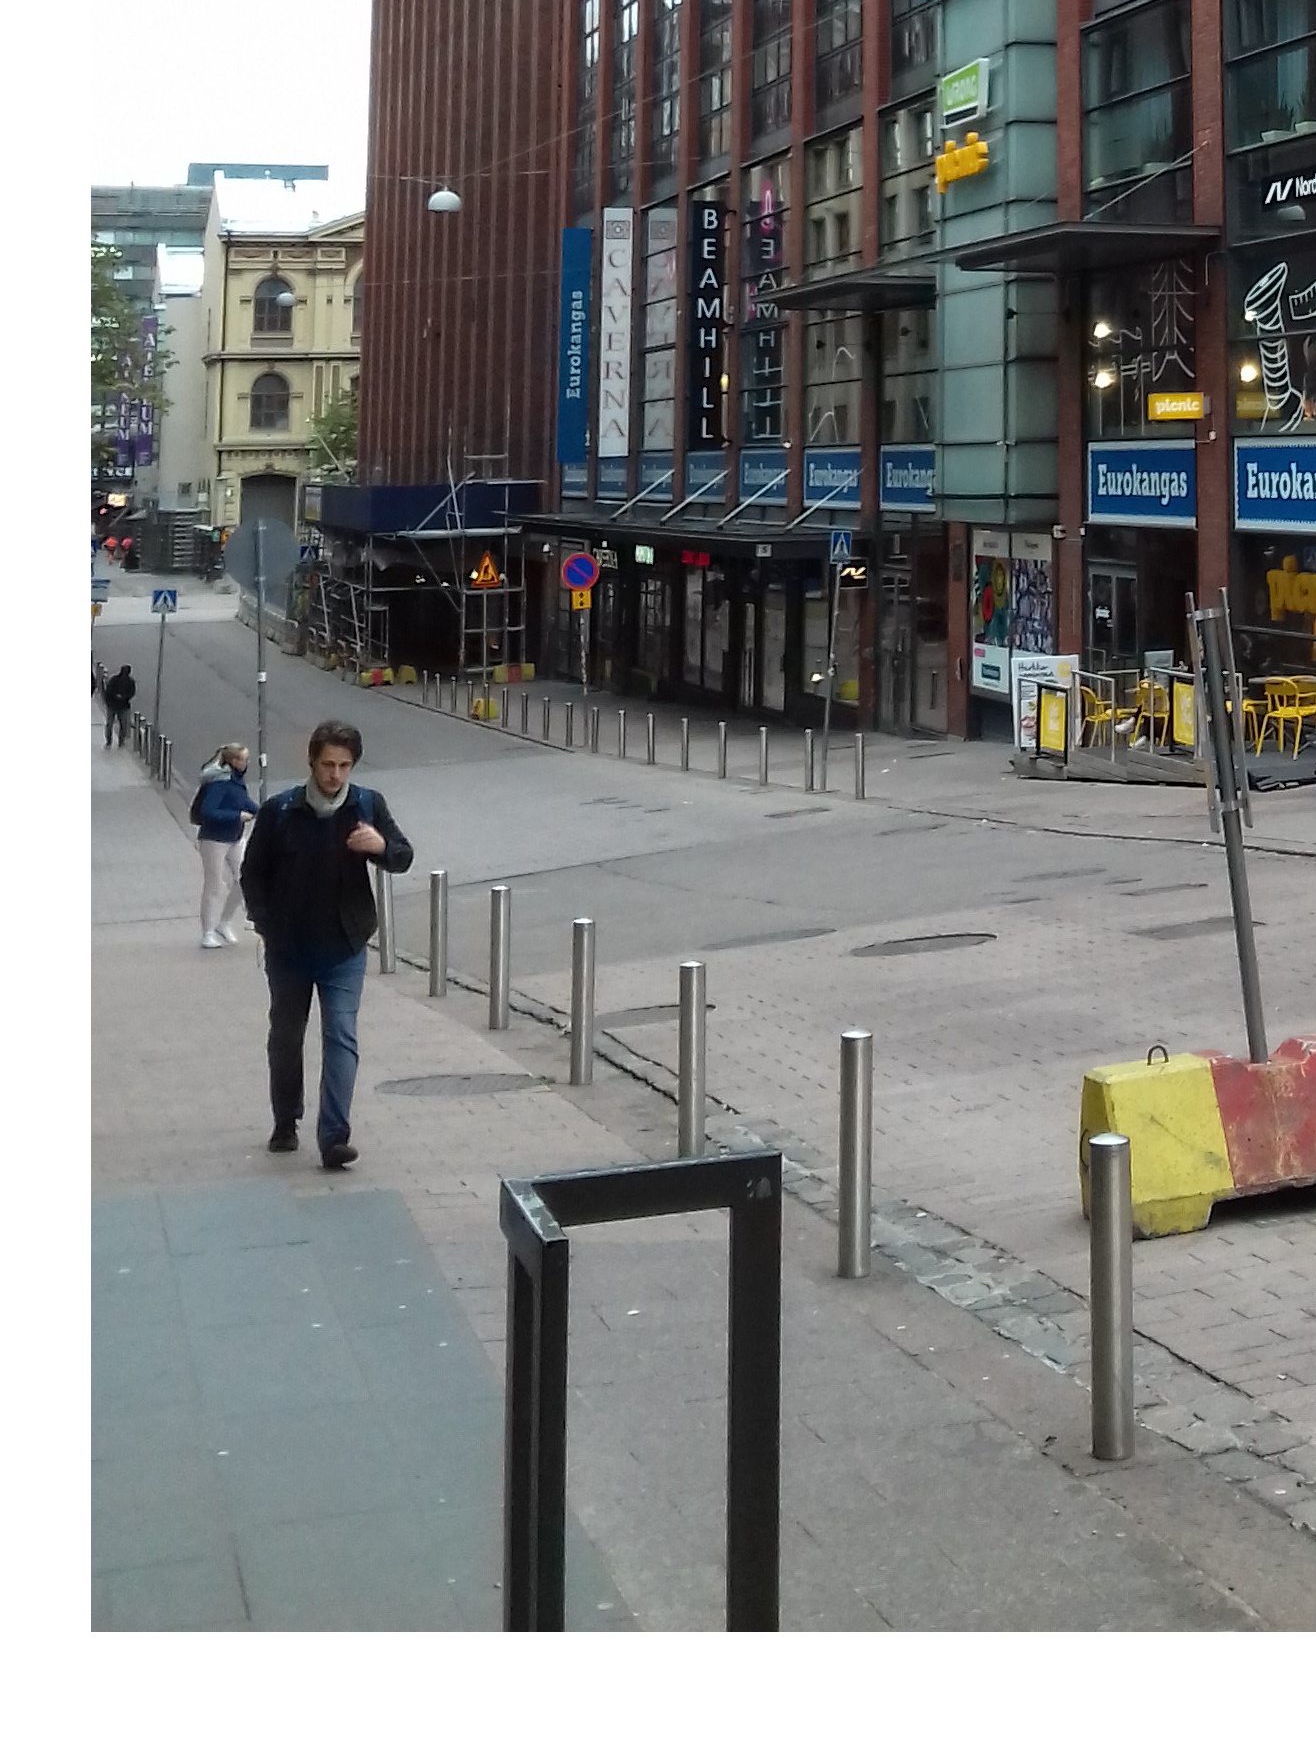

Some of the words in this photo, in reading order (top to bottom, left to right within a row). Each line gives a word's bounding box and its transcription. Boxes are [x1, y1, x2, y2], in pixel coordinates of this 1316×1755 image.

[566, 290, 584, 400] Eurokangas
[601, 249, 629, 438] CAVERNA
[697, 208, 721, 439] BEAMHILL
[1154, 398, 1200, 415] picnic
[1097, 463, 1187, 505] Eurokangas
